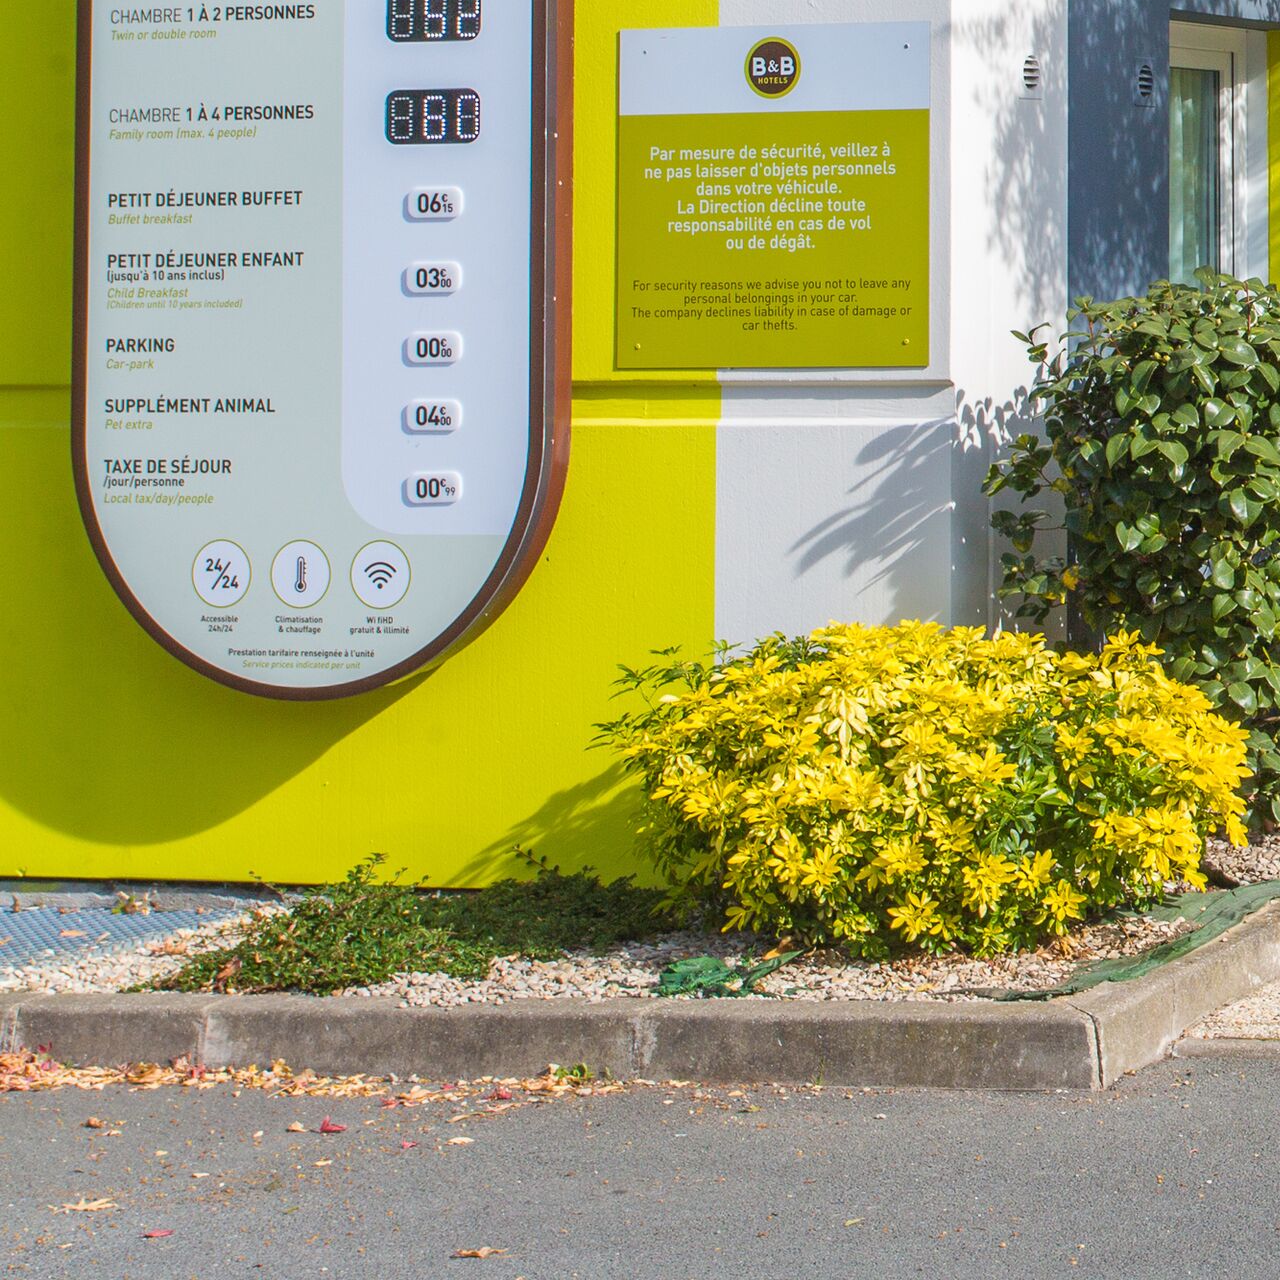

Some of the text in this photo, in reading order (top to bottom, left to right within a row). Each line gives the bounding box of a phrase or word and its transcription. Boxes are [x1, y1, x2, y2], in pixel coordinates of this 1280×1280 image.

[111, 4, 315, 24] CHAMBRE 1 À 2 PERSONNES
[111, 30, 216, 41] Twin or double room
[752, 56, 794, 76] B&B
[758, 76, 788, 84] HOTELS
[109, 103, 314, 124] CHAMBRE 1 À 4 PERSONNES
[109, 129, 144, 141] Family
[146, 130, 173, 139] room
[208, 127, 214, 137] 4
[217, 126, 257, 140] people)
[650, 142, 890, 160] Par mesure de sécurité, veillez à
[645, 161, 896, 181] ne pas laisser d'objets personnels
[696, 180, 842, 196] dans votre véhicule.
[108, 189, 303, 208] PETIT DÉJEUNER BUFFET
[677, 198, 865, 215] La Direction décline toute
[108, 213, 192, 224] Buffet breakfast
[668, 216, 871, 235] responsabilité en cas de vol
[726, 234, 815, 252] ou de dégât.
[107, 250, 304, 268] PETIT DÉJEUNER ENFANT
[153, 271, 164, 281] 10
[167, 272, 186, 280] ans
[189, 269, 224, 281] inclus)
[633, 278, 911, 292] For security reasons we advise you not to leave any
[107, 288, 188, 298] Child Breakfast
[684, 292, 857, 306] personal belongings in your car.
[147, 300, 167, 308] until
[169, 300, 178, 308] 10
[179, 301, 202, 309] years
[632, 305, 912, 320] The company declines liability in case of damage or
[742, 319, 797, 331] car thefts.
[106, 338, 175, 352] PARKING
[106, 359, 154, 371] Car-park
[105, 394, 275, 413] SUPPLÉMENT ANIMAL
[105, 419, 153, 430] Pet extra
[104, 455, 232, 473] TAXE DE SÉJOUR
[103, 476, 185, 488] /jour/personne
[104, 493, 214, 505] Local tax/day/people
[201, 615, 239, 623] Accessible
[286, 626, 321, 634] chauffage
[350, 626, 374, 635] gratuit
[384, 626, 409, 634] illimité
[228, 648, 266, 656] Prestation
[301, 649, 342, 658] renseignée
[344, 649, 349, 657] à
[242, 660, 360, 671] Service prices indicated per unit
